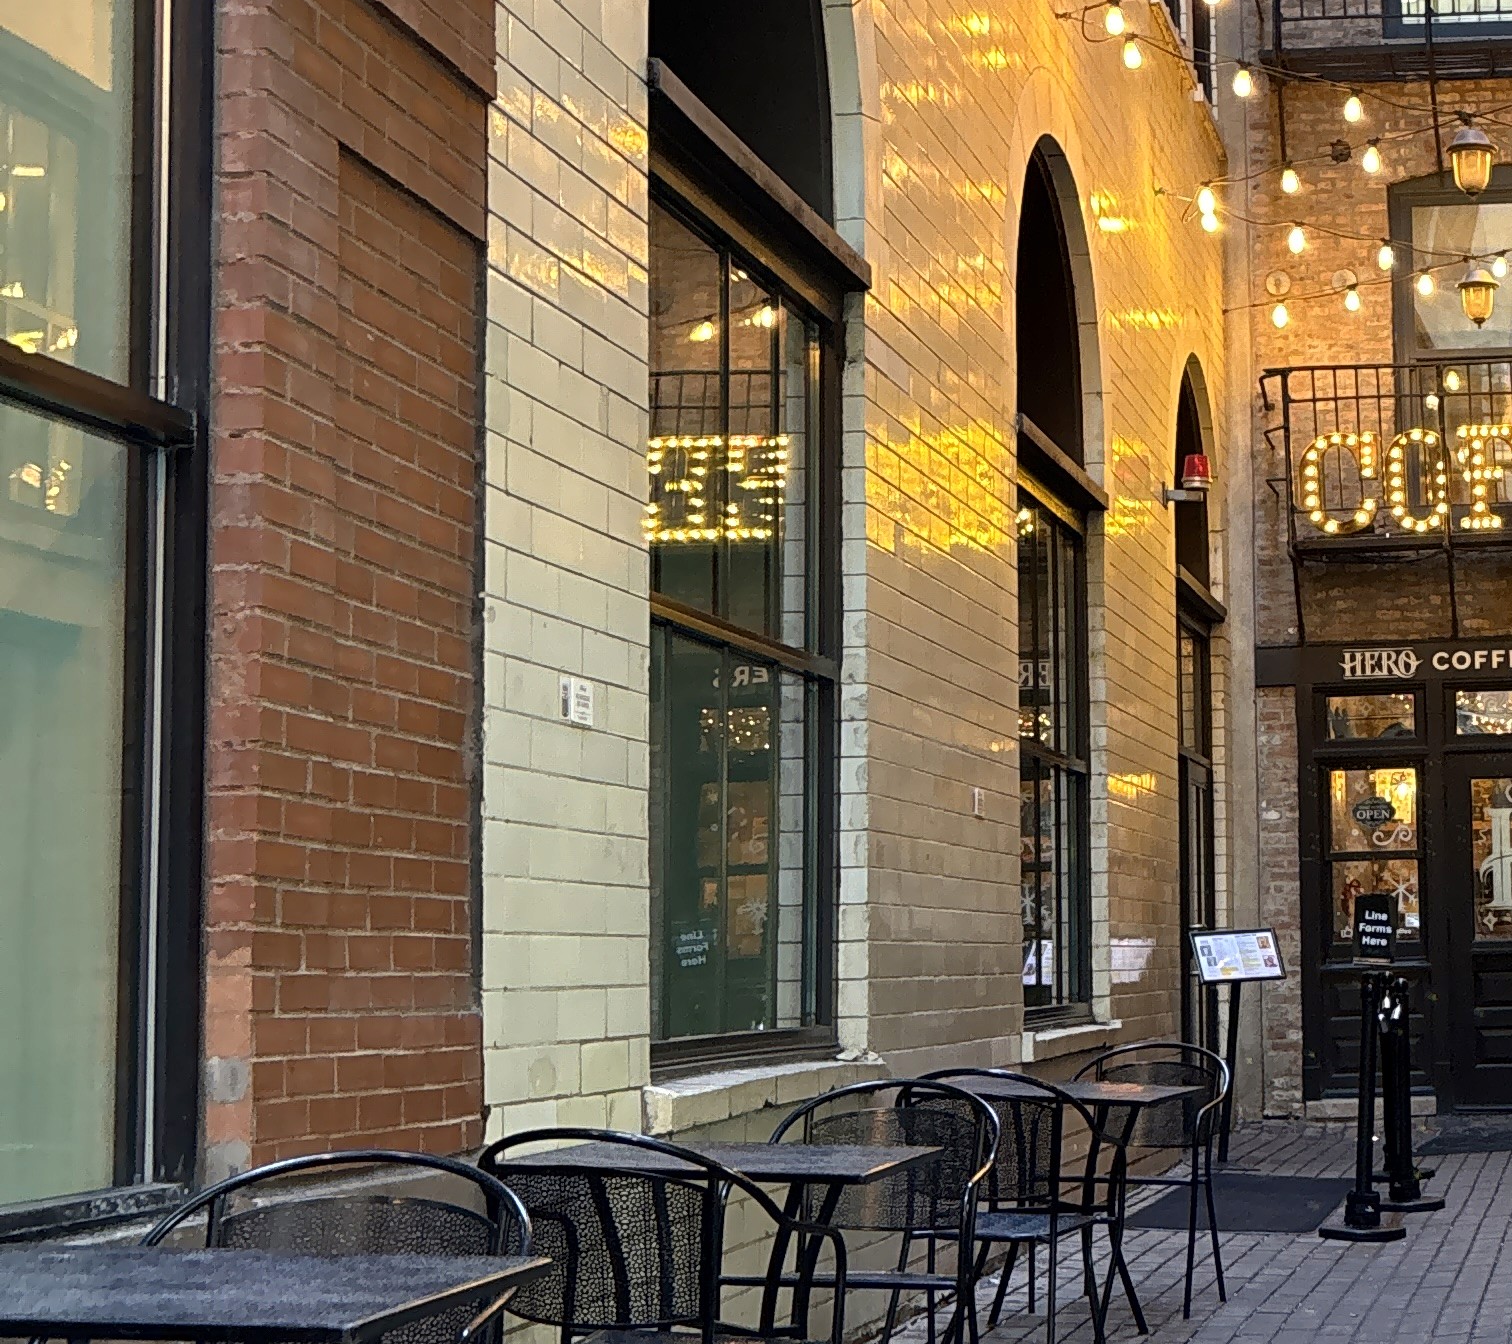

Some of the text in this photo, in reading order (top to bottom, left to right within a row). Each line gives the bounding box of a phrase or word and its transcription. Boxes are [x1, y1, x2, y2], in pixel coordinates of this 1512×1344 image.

[1338, 647, 1424, 680] HERO
[1356, 809, 1391, 821] OPEN
[1365, 909, 1388, 921] Line
[1359, 922, 1392, 934] Forms
[1362, 935, 1388, 946] Here
